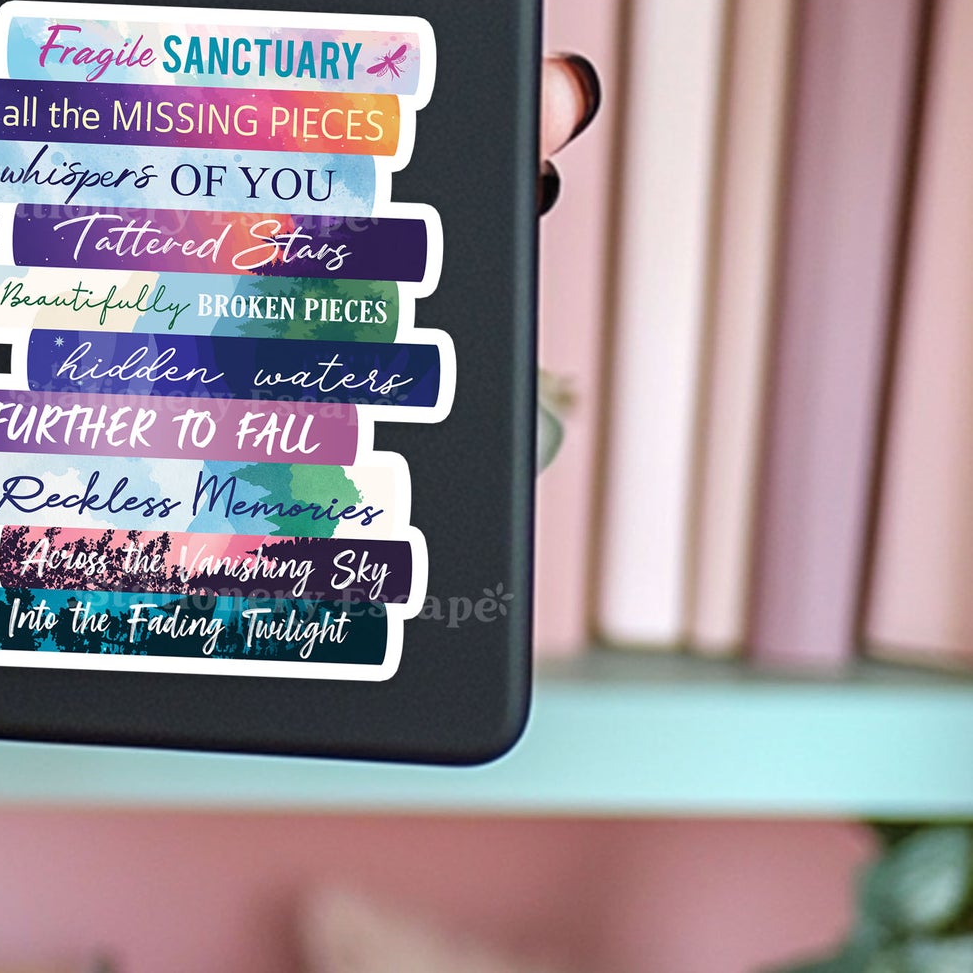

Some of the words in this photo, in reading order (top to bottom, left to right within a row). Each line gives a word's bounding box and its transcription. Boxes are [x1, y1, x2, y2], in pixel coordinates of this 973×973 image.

[38, 24, 155, 82] Fragile
[162, 35, 363, 81] SANCTUARY
[2, 96, 36, 128] all
[48, 97, 100, 130] the
[112, 102, 259, 137] MISSING
[271, 107, 384, 142] PIECES
[0, 145, 158, 204] whispers
[170, 164, 227, 197] OF
[238, 166, 336, 201] YOU
[53, 213, 230, 263] Tattered
[231, 219, 352, 271] Stars
[0, 280, 192, 330] Beautifully
[198, 294, 298, 321] BROKEN
[304, 298, 389, 325] PIECES
[57, 341, 226, 383] hidden
[254, 349, 413, 394] waters
[173, 409, 214, 449] TO
[236, 412, 323, 455] FALL
[192, 472, 384, 528] Memories
[19, 538, 113, 578] Across
[123, 540, 165, 574] the
[179, 545, 316, 598] Vanishing
[330, 549, 392, 603] Sky
[8, 601, 58, 638] Into
[69, 600, 110, 635] the
[127, 604, 226, 655] Fading
[242, 608, 352, 658] Twilight
